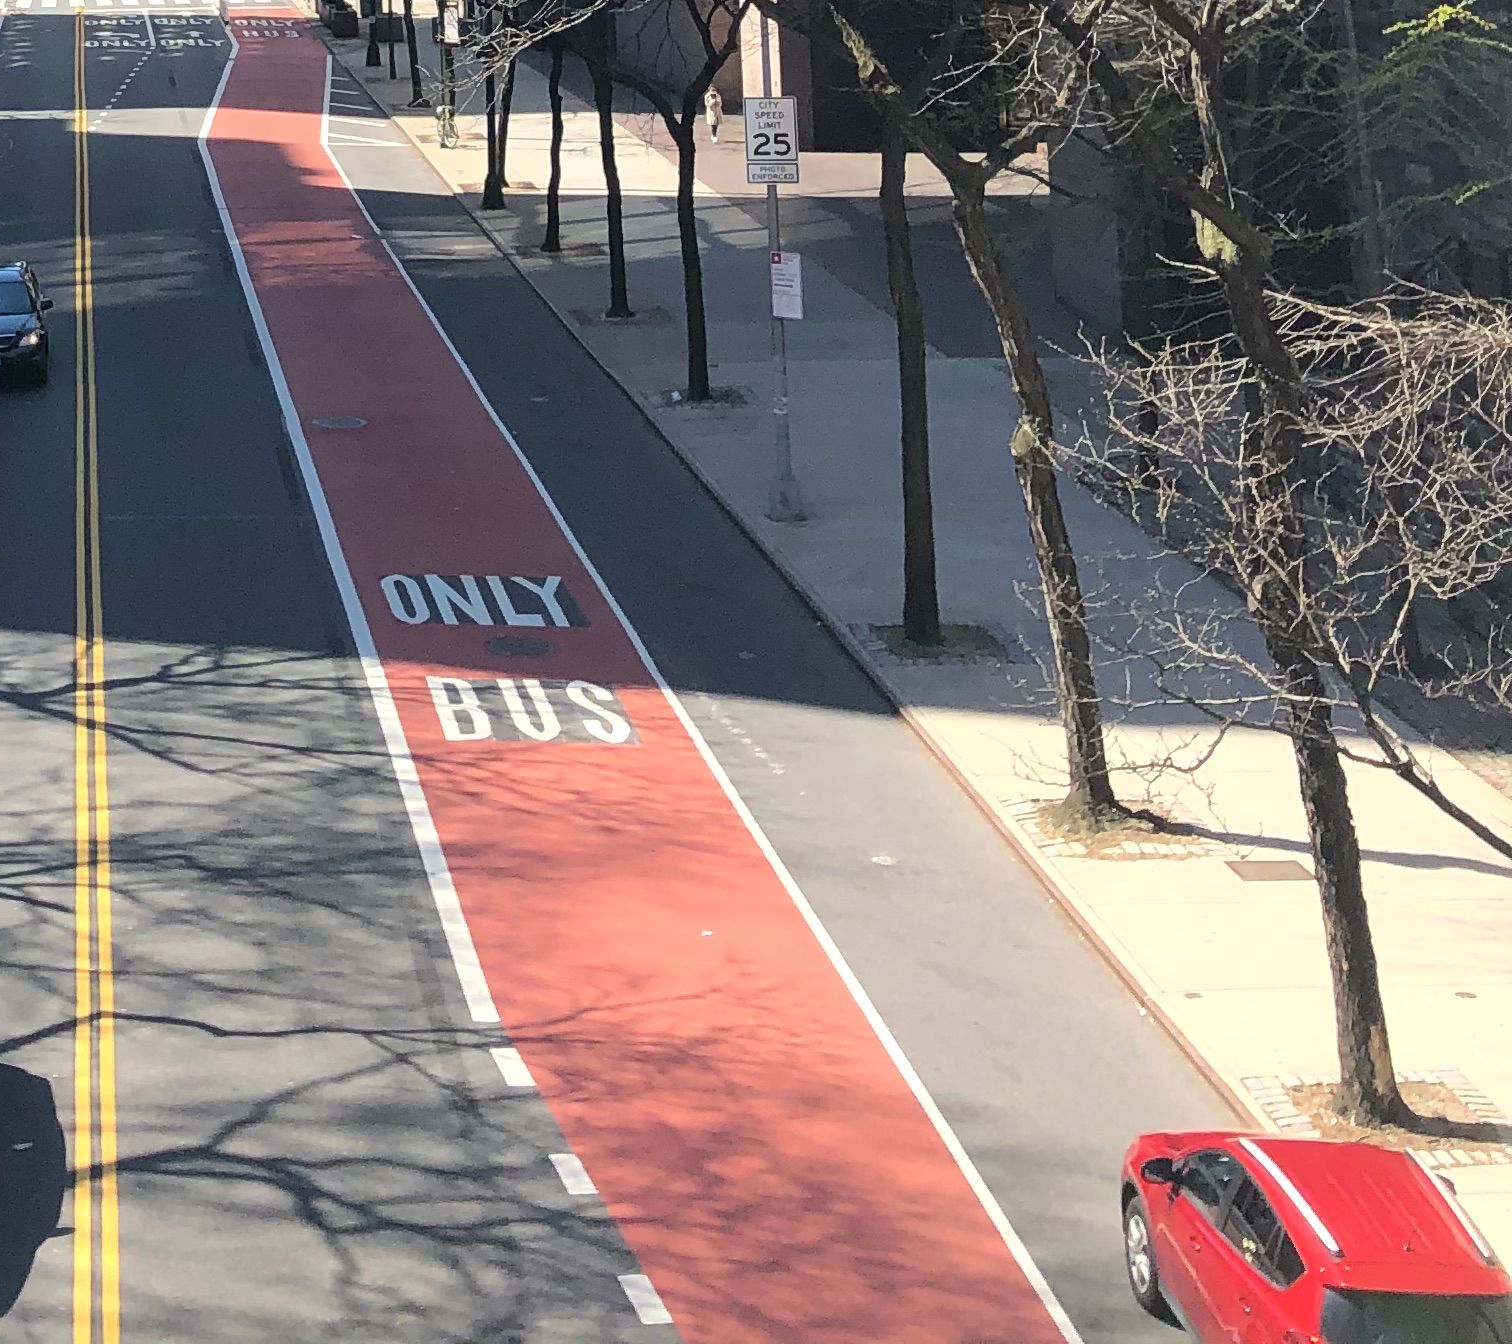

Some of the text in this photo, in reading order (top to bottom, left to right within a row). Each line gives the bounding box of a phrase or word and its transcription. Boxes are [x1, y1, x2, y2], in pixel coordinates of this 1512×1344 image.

[234, 19, 295, 27] ONLY
[758, 101, 779, 110] CITY
[754, 111, 785, 120] SPEED
[758, 121, 782, 130] LIMIT
[752, 132, 792, 157] 25
[759, 166, 786, 174] PHOTO
[751, 173, 795, 181] ENFORCED
[379, 573, 571, 628] ONLY
[425, 674, 632, 744] BUS
